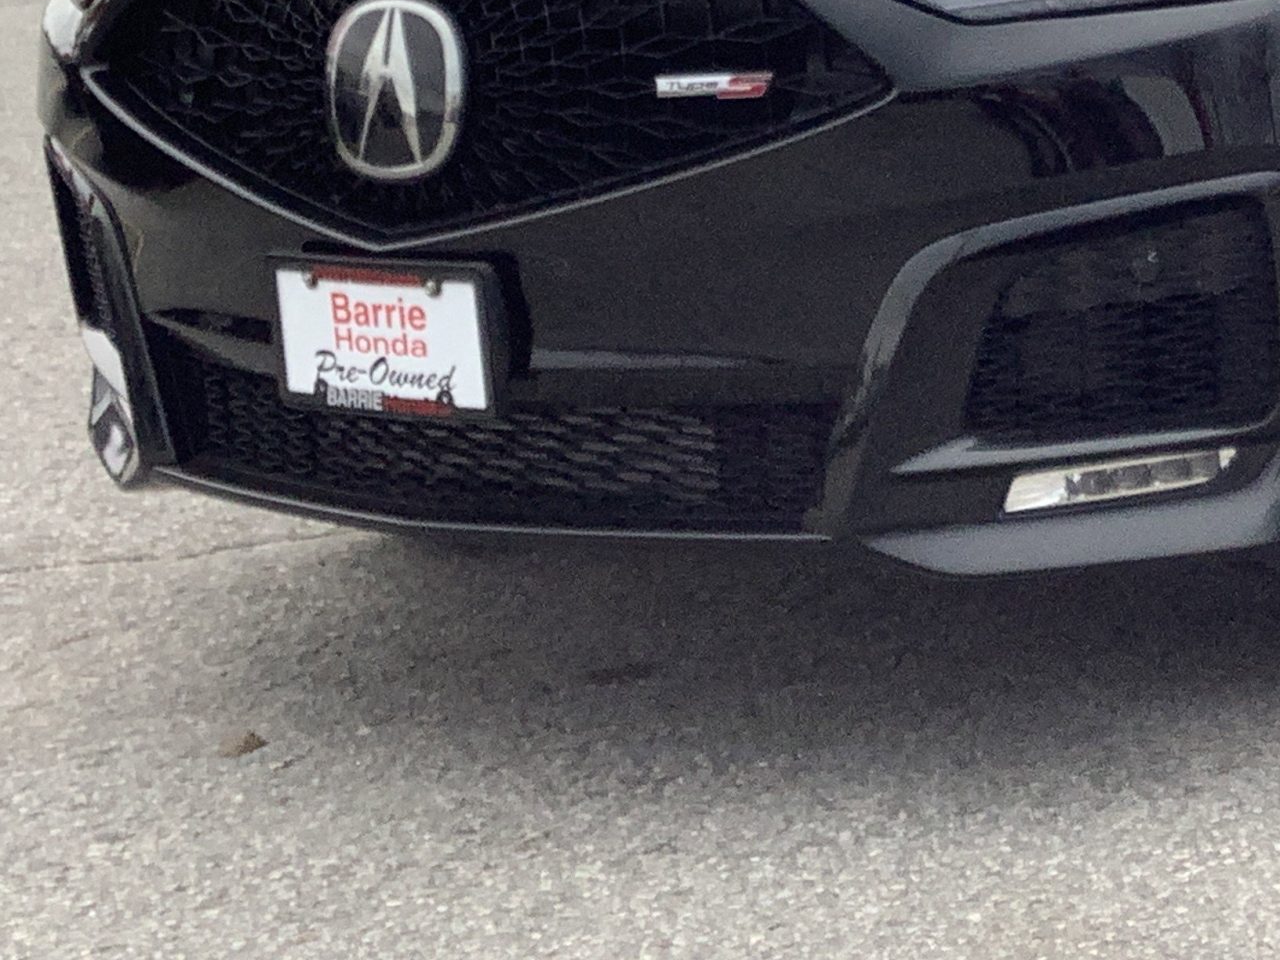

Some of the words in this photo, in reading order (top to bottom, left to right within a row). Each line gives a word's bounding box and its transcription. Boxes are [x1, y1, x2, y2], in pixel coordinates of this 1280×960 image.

[330, 292, 427, 331] Barrie
[334, 327, 427, 357] Honda
[316, 350, 456, 391] Pre-Owned
[327, 387, 385, 411] BARRIE
